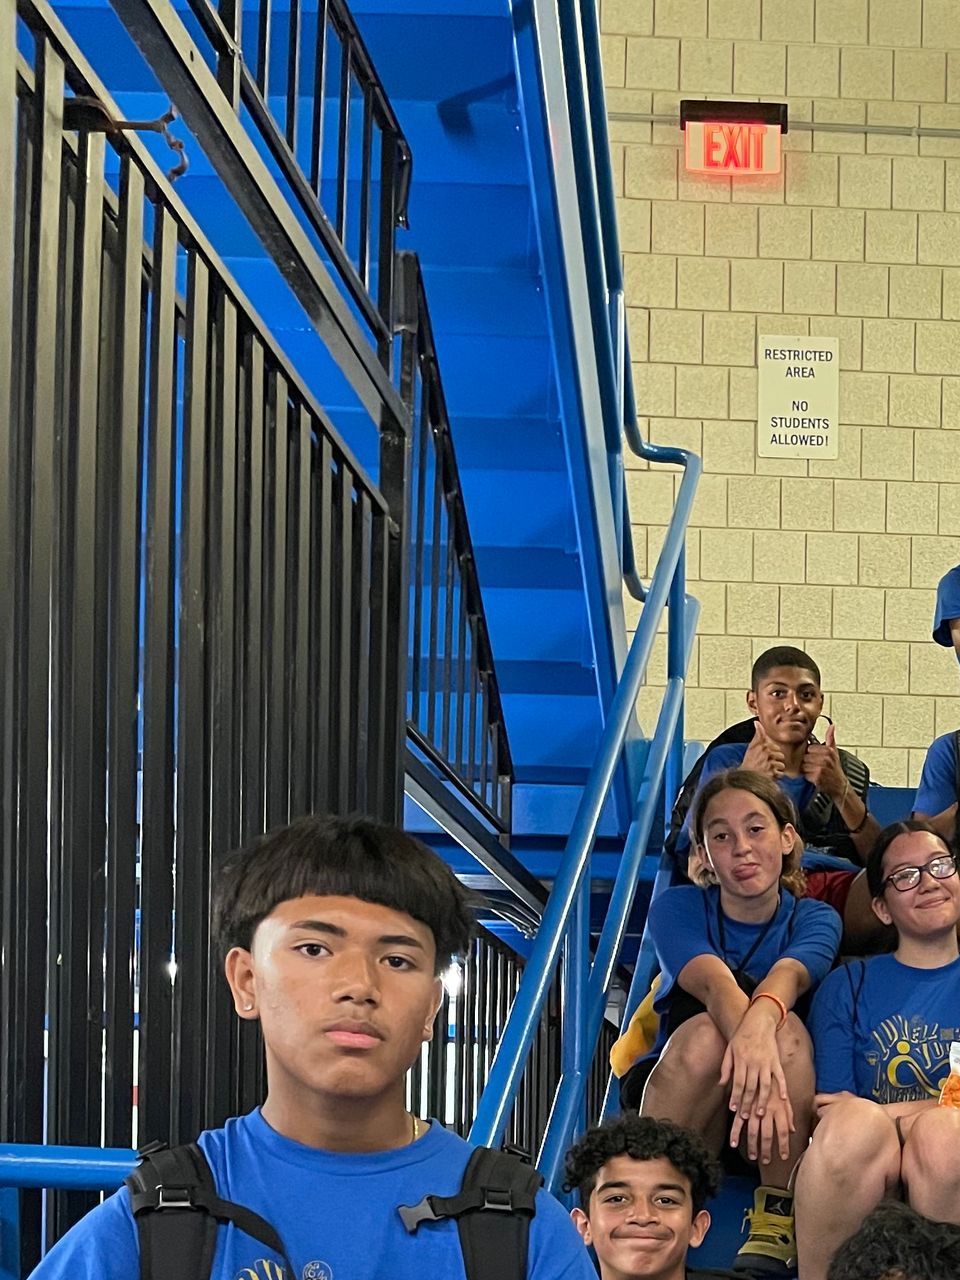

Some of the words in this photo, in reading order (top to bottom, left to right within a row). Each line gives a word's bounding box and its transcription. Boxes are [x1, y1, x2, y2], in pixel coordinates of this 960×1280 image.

[703, 124, 768, 169] EXIT
[764, 348, 833, 363] RESTRICTED
[785, 366, 816, 379] AREA
[791, 400, 809, 413] NO
[770, 416, 830, 430] STUDENTS
[770, 432, 829, 447] ALLOWED!
